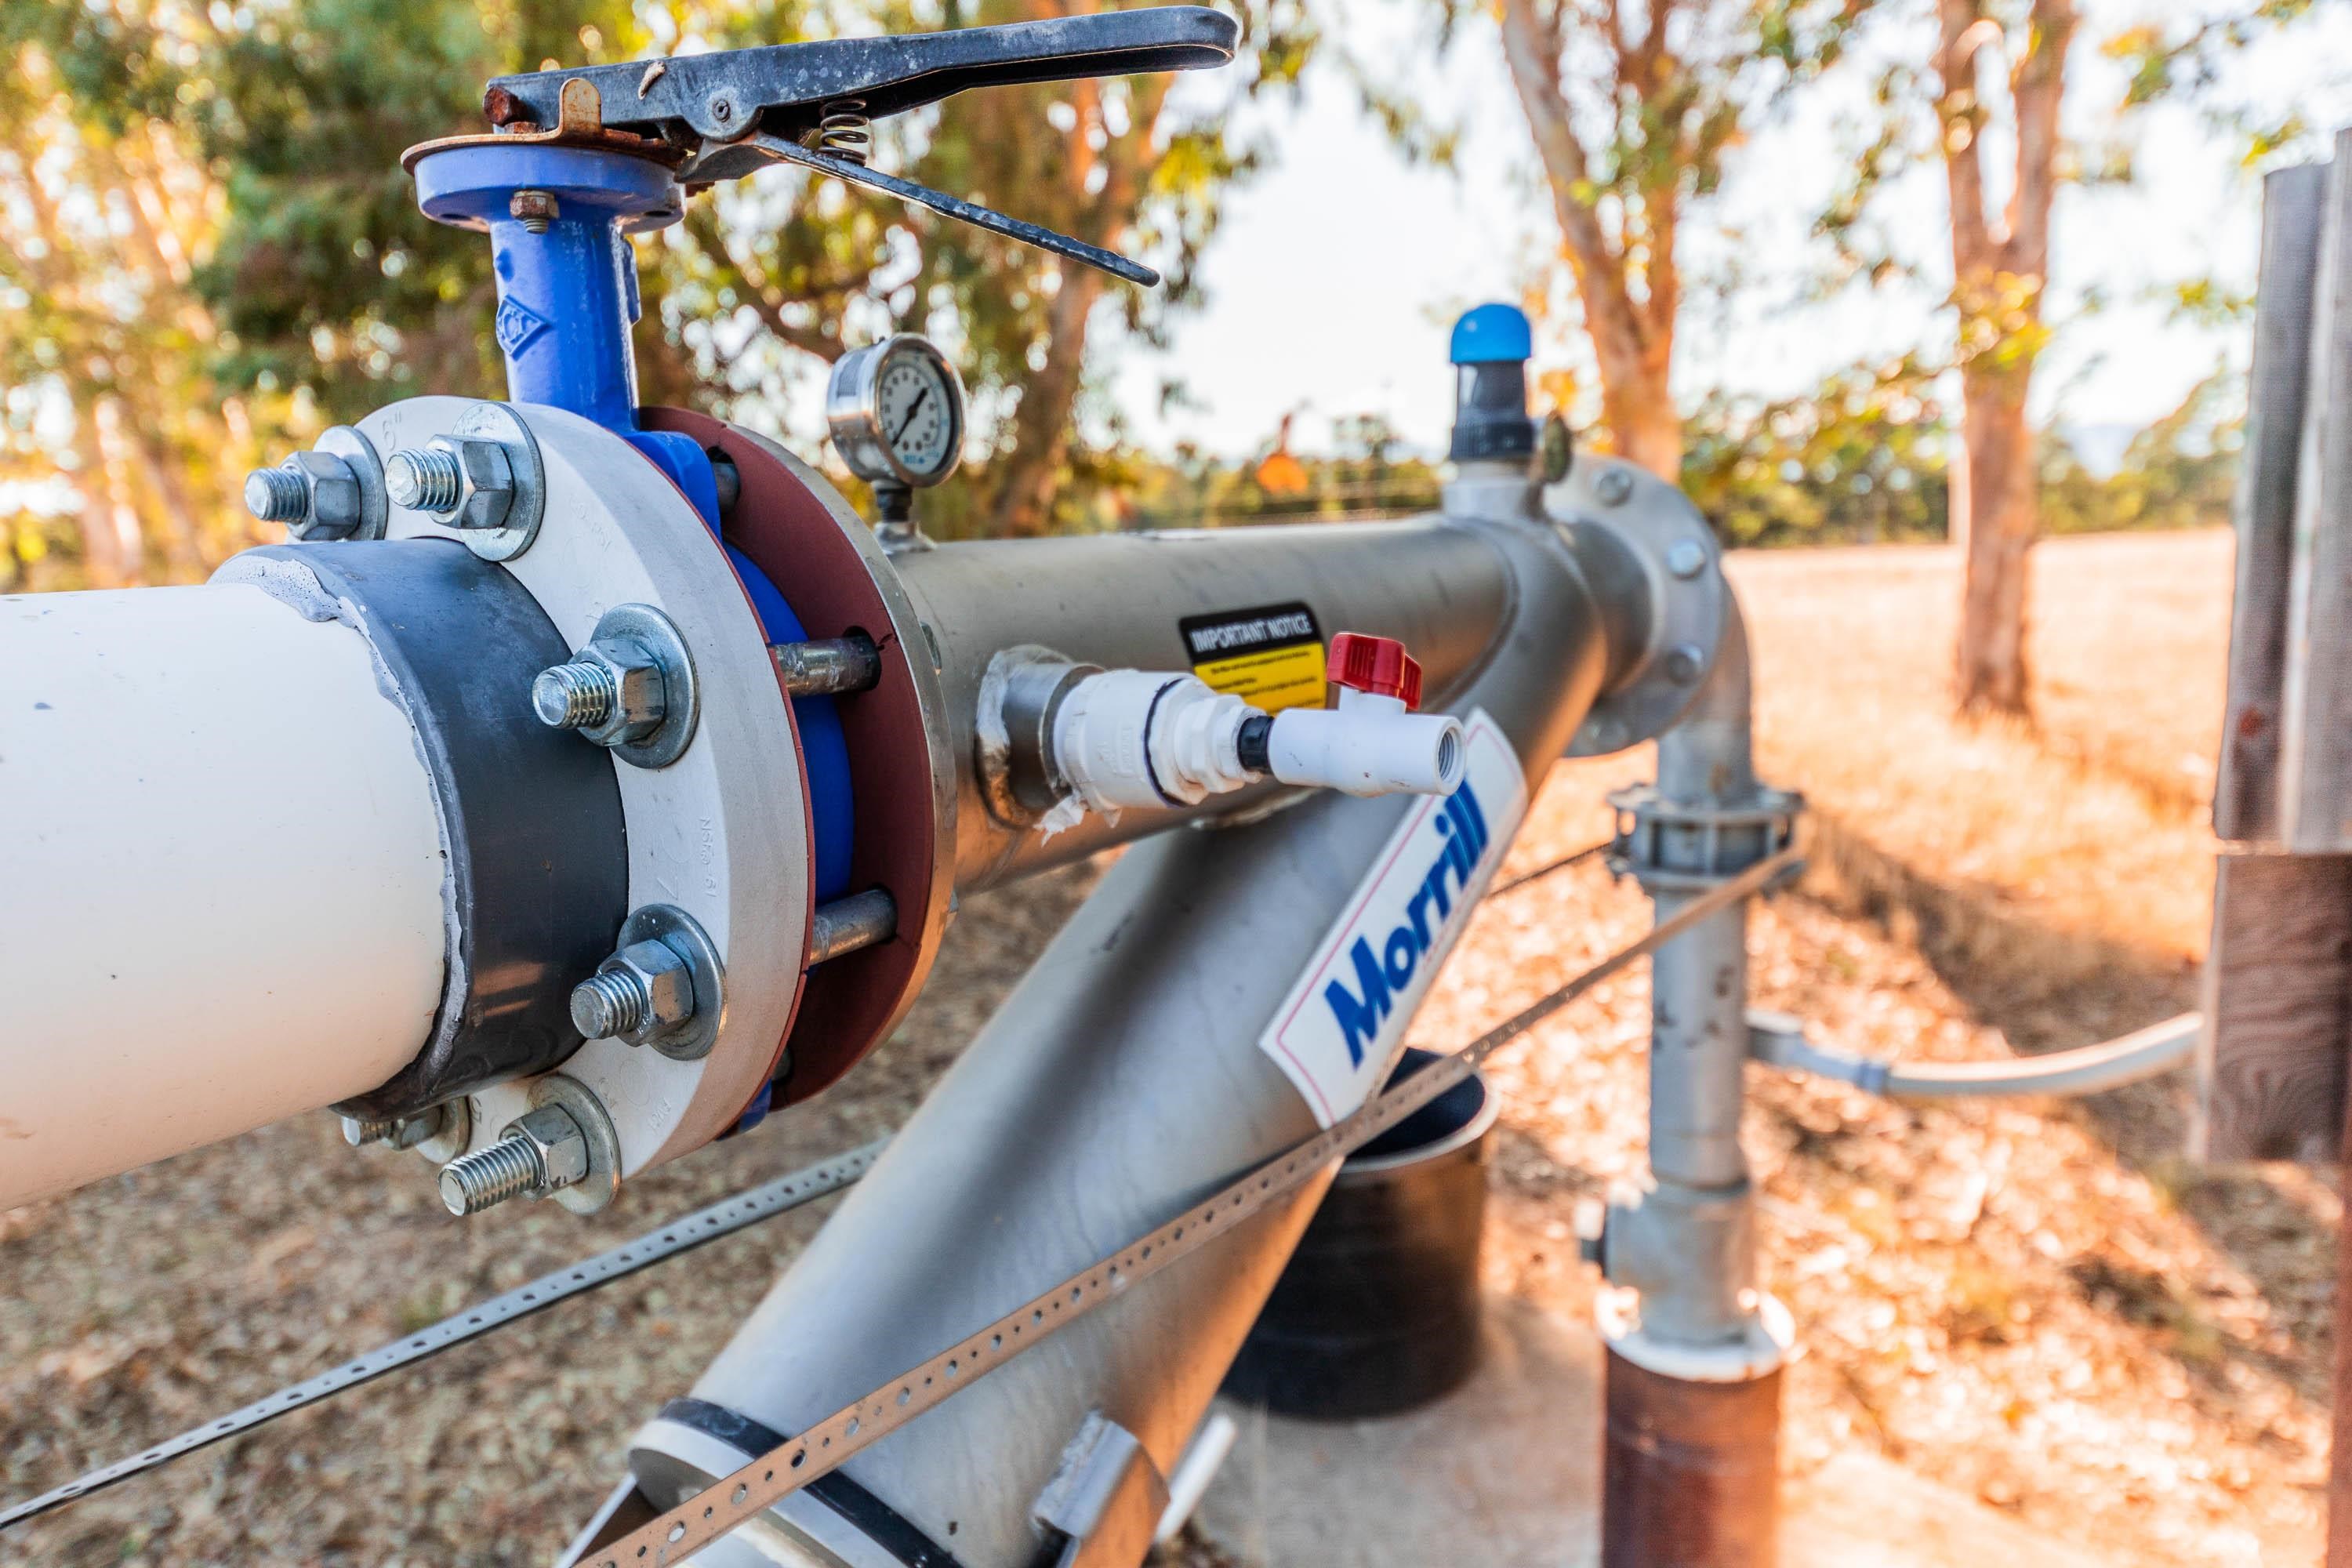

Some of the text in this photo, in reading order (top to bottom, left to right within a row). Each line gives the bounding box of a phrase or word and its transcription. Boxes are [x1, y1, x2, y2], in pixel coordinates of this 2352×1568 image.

[1190, 611, 1312, 653] IMPORTANT NOTICE
[1324, 779, 1488, 1073] Morrill
